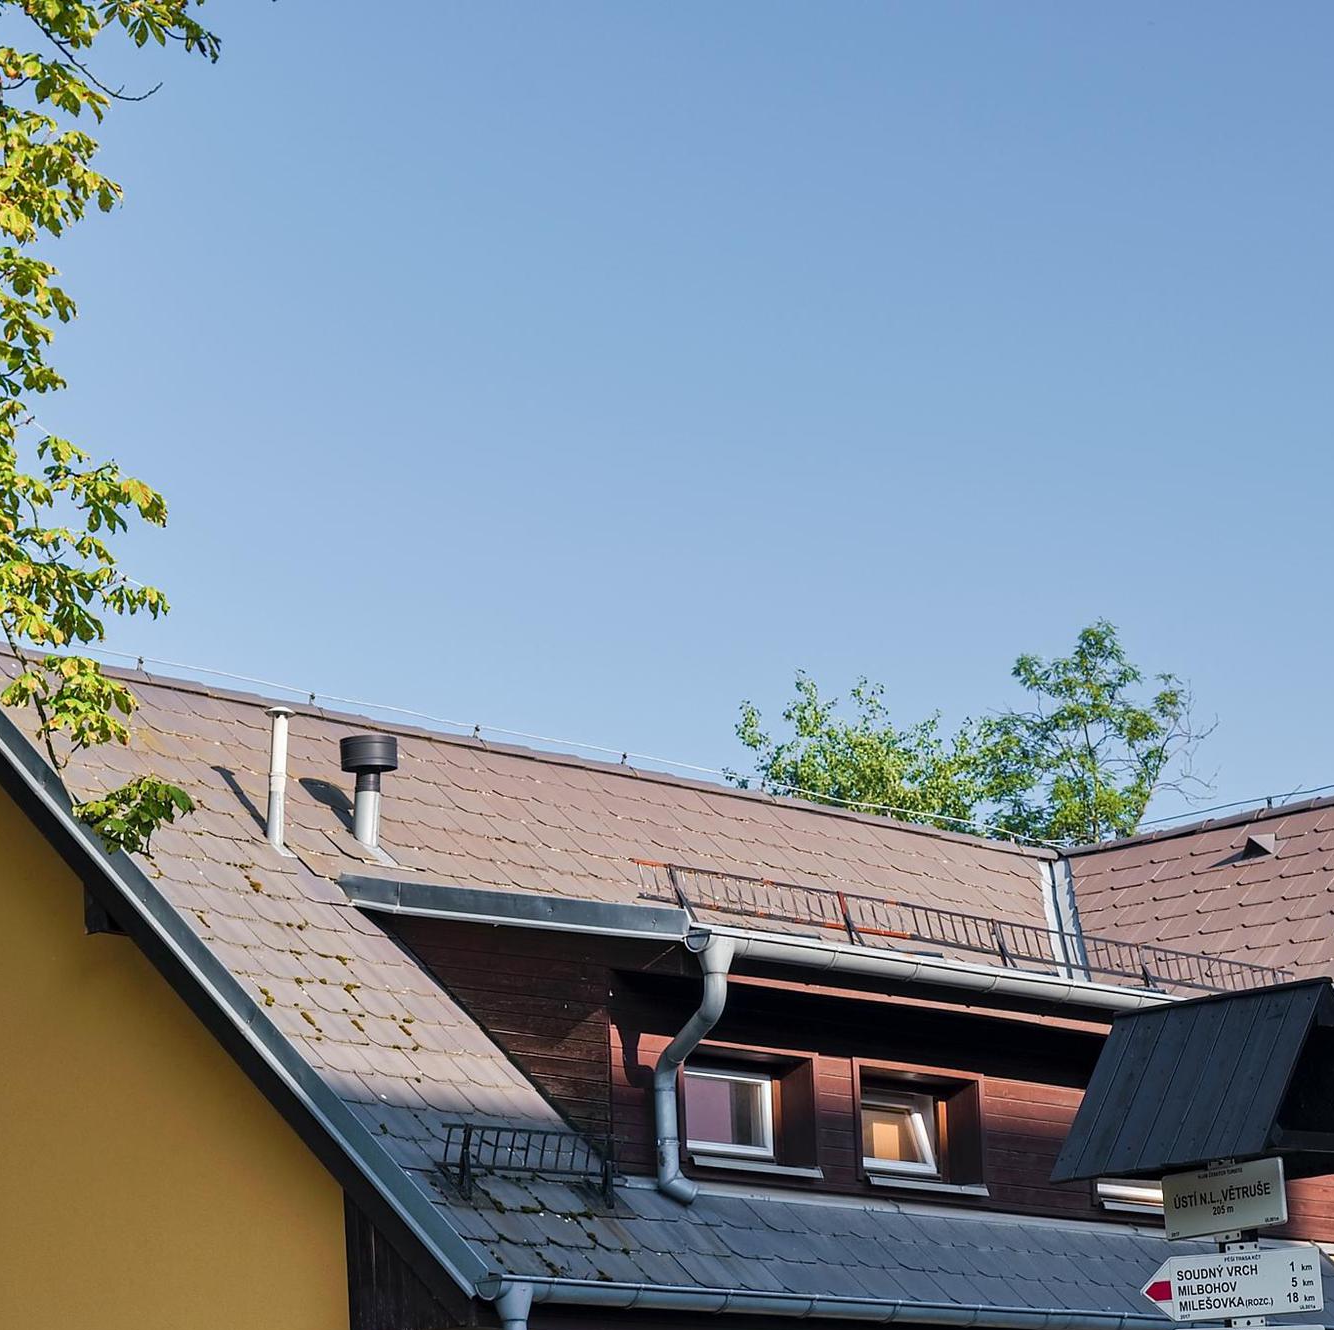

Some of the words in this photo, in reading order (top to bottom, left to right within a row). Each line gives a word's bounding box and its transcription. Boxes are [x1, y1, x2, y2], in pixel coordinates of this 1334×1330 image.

[1173, 1192, 1197, 1209] ÚSTÍ
[1212, 1206, 1226, 1216] 205
[1227, 1205, 1234, 1213] m
[1177, 1265, 1224, 1281] SOUDNÝ
[1227, 1264, 1258, 1277] VRCH
[1289, 1261, 1295, 1272] 1
[1301, 1263, 1313, 1271] km
[1178, 1281, 1237, 1296] MILBOHOV
[1291, 1277, 1298, 1288] 5
[1302, 1278, 1314, 1286] km
[1286, 1292, 1299, 1303] 18
[1304, 1294, 1316, 1302] km
